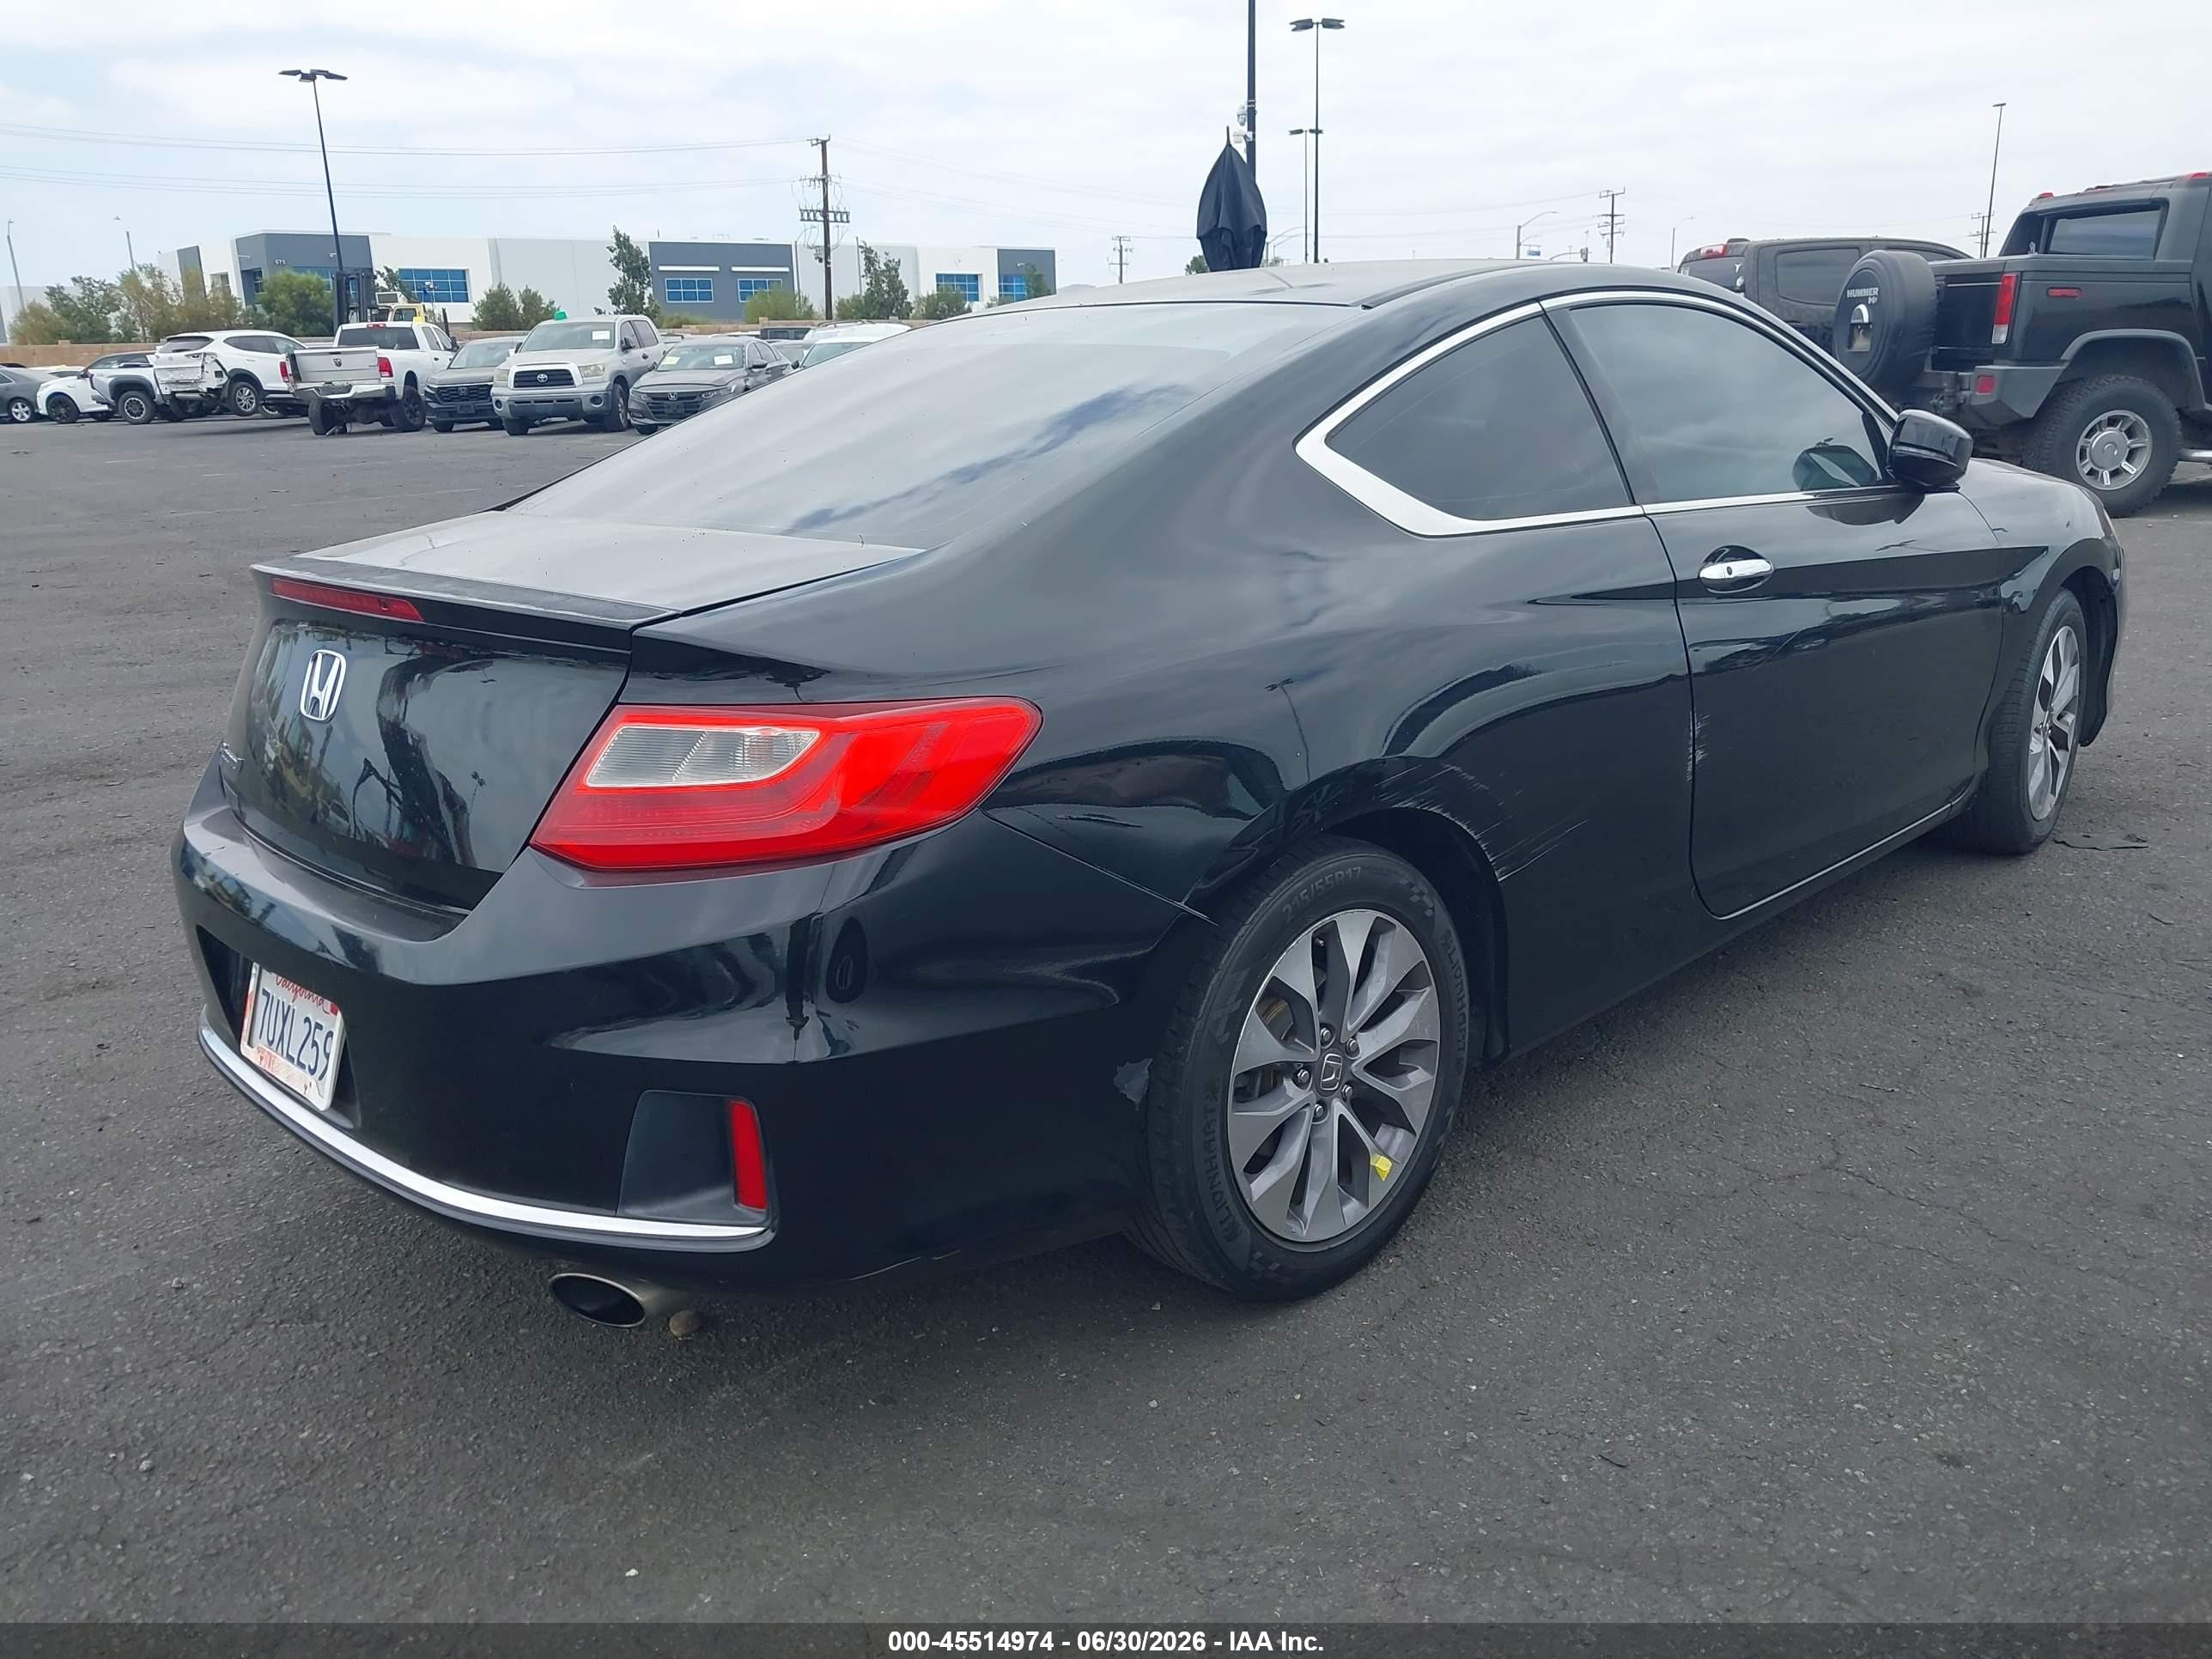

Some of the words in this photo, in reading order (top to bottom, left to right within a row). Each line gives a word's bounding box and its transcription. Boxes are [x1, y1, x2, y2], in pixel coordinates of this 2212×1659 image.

[1847, 288, 1879, 298] HUMMER
[259, 988, 335, 1081] 7UXL259
[1203, 1104, 1234, 1225] LIONHART
